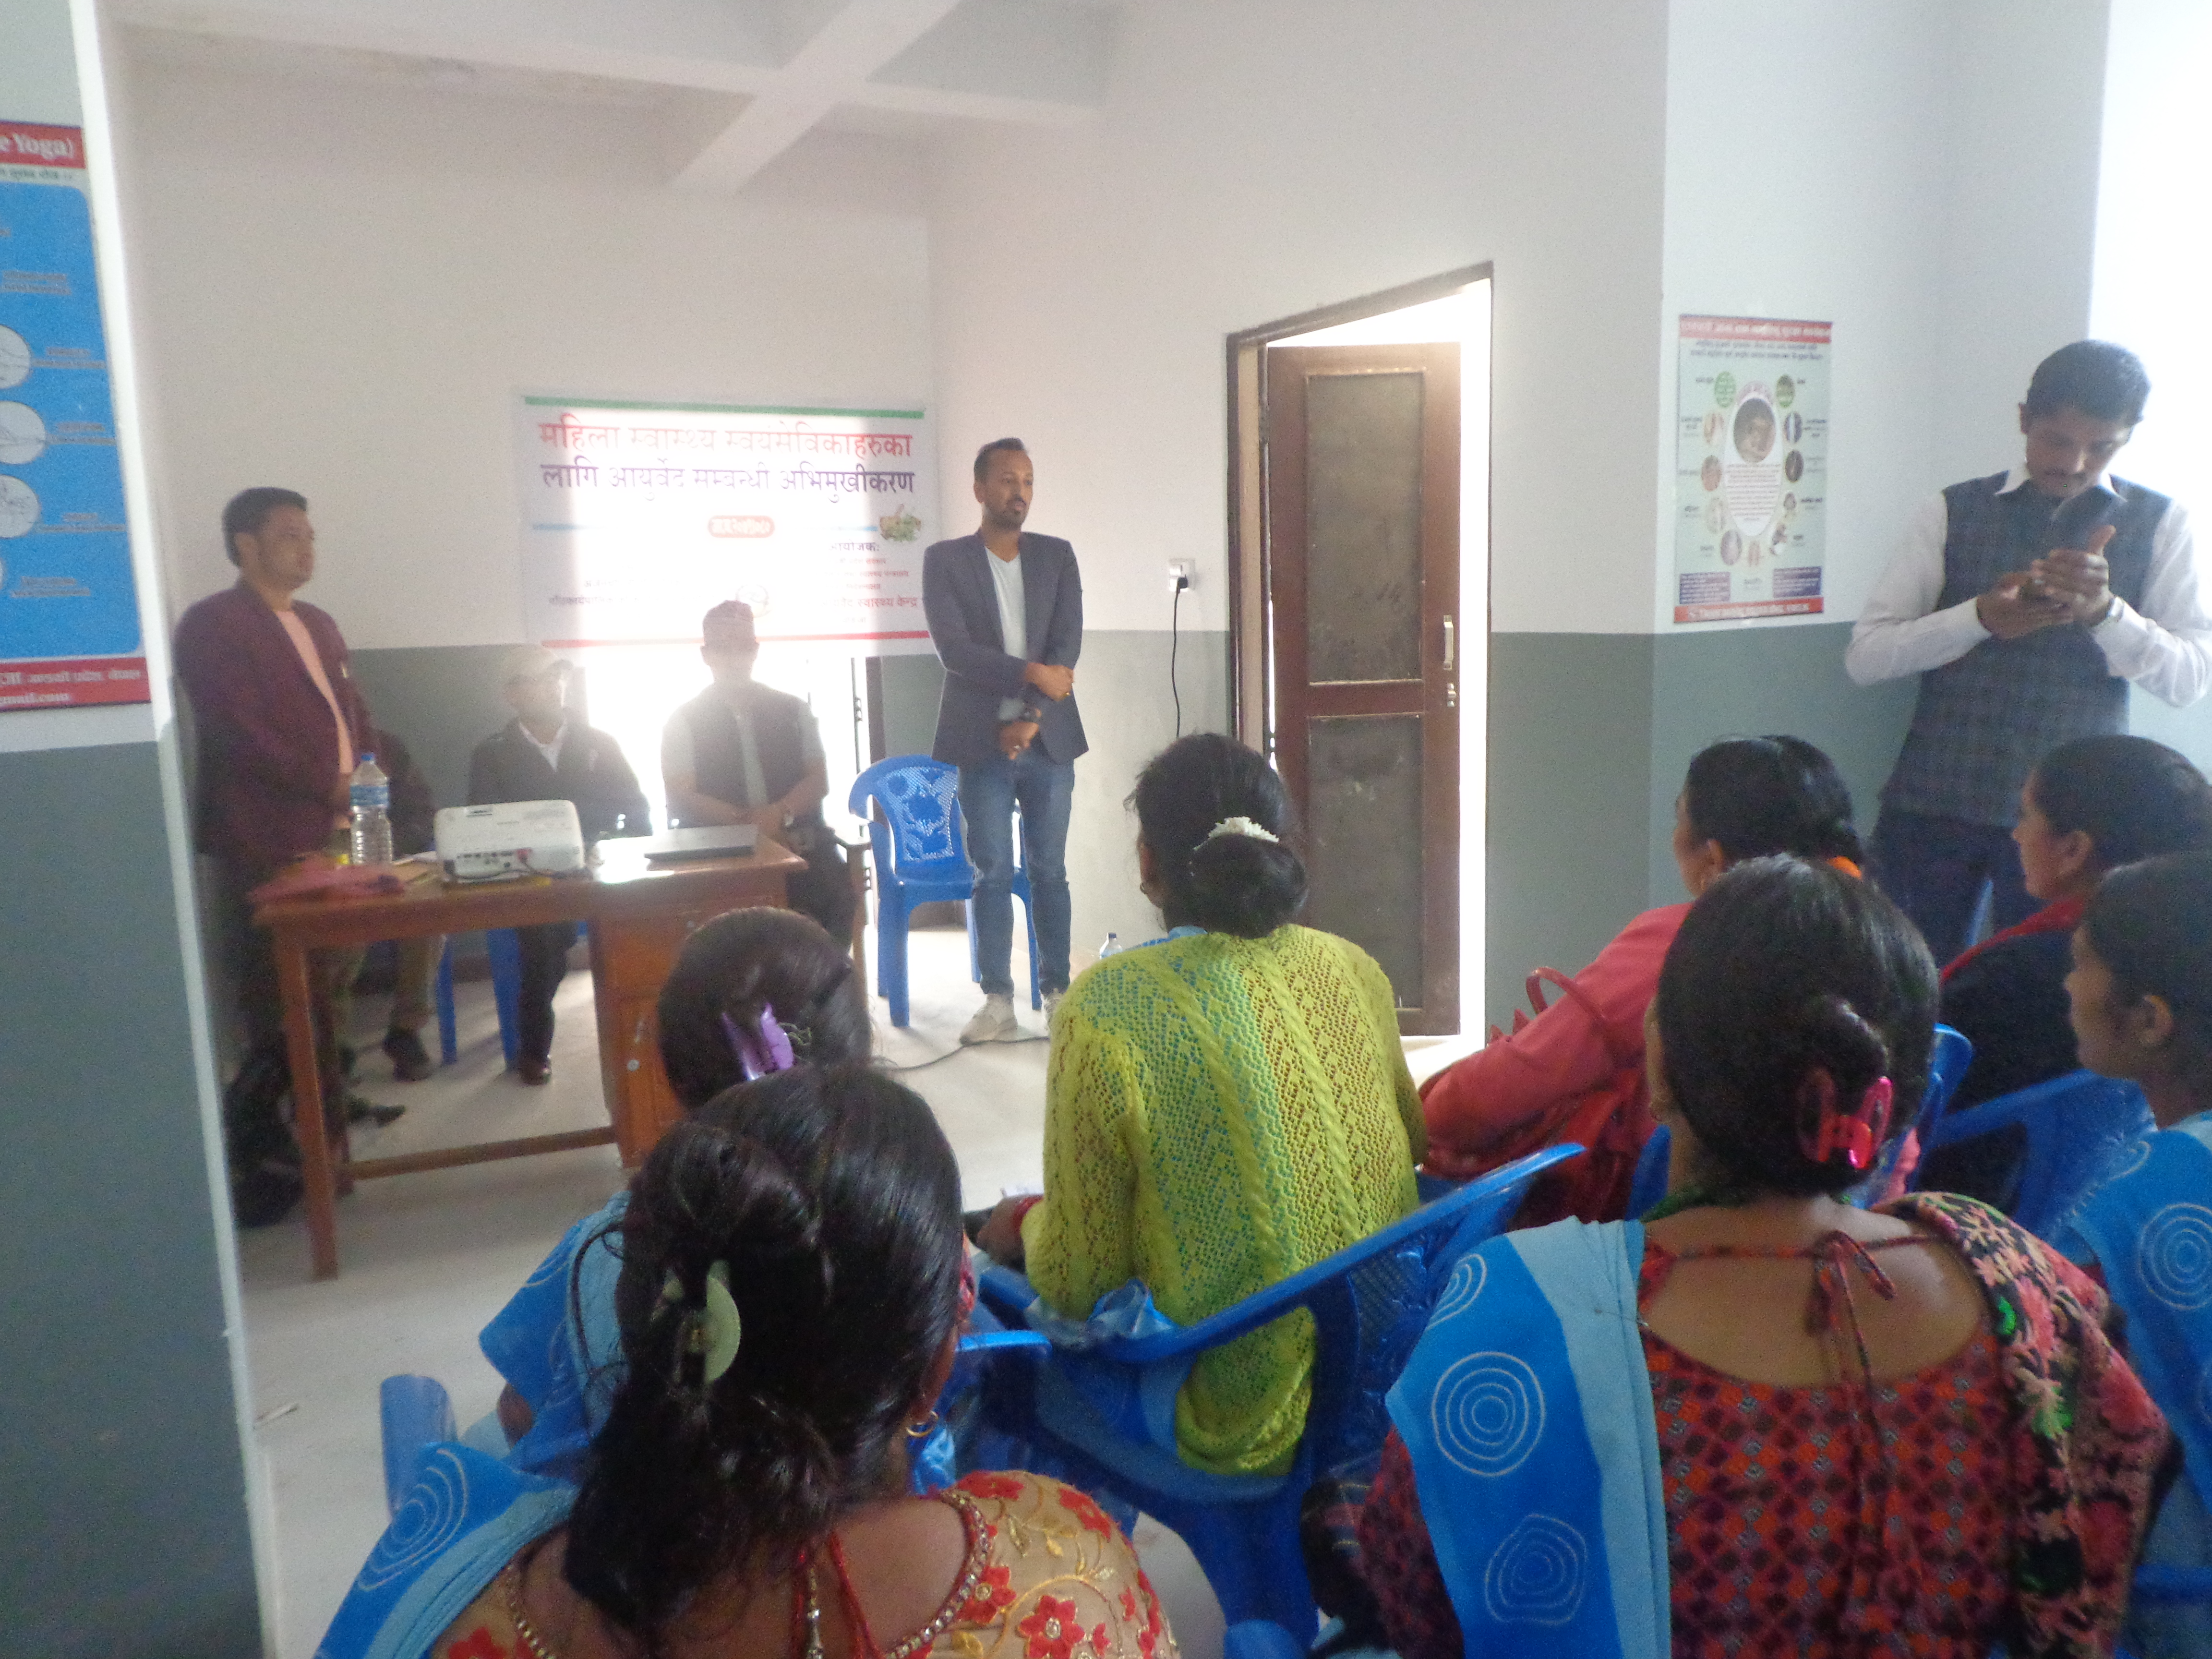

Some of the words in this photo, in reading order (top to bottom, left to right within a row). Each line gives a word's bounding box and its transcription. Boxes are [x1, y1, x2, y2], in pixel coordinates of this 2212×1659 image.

[12, 132, 74, 160] Yoga)
[538, 413, 621, 452] महिला
[628, 427, 718, 451] स्वास्थ्य
[540, 455, 599, 488] लागि
[609, 457, 685, 501] आयुर्वेद
[692, 461, 770, 489] सम्बन्धी
[780, 461, 916, 503] अभिमुखीकरण
[857, 597, 894, 608] स्वास्थ्य
[897, 595, 918, 607] केन्द्र
